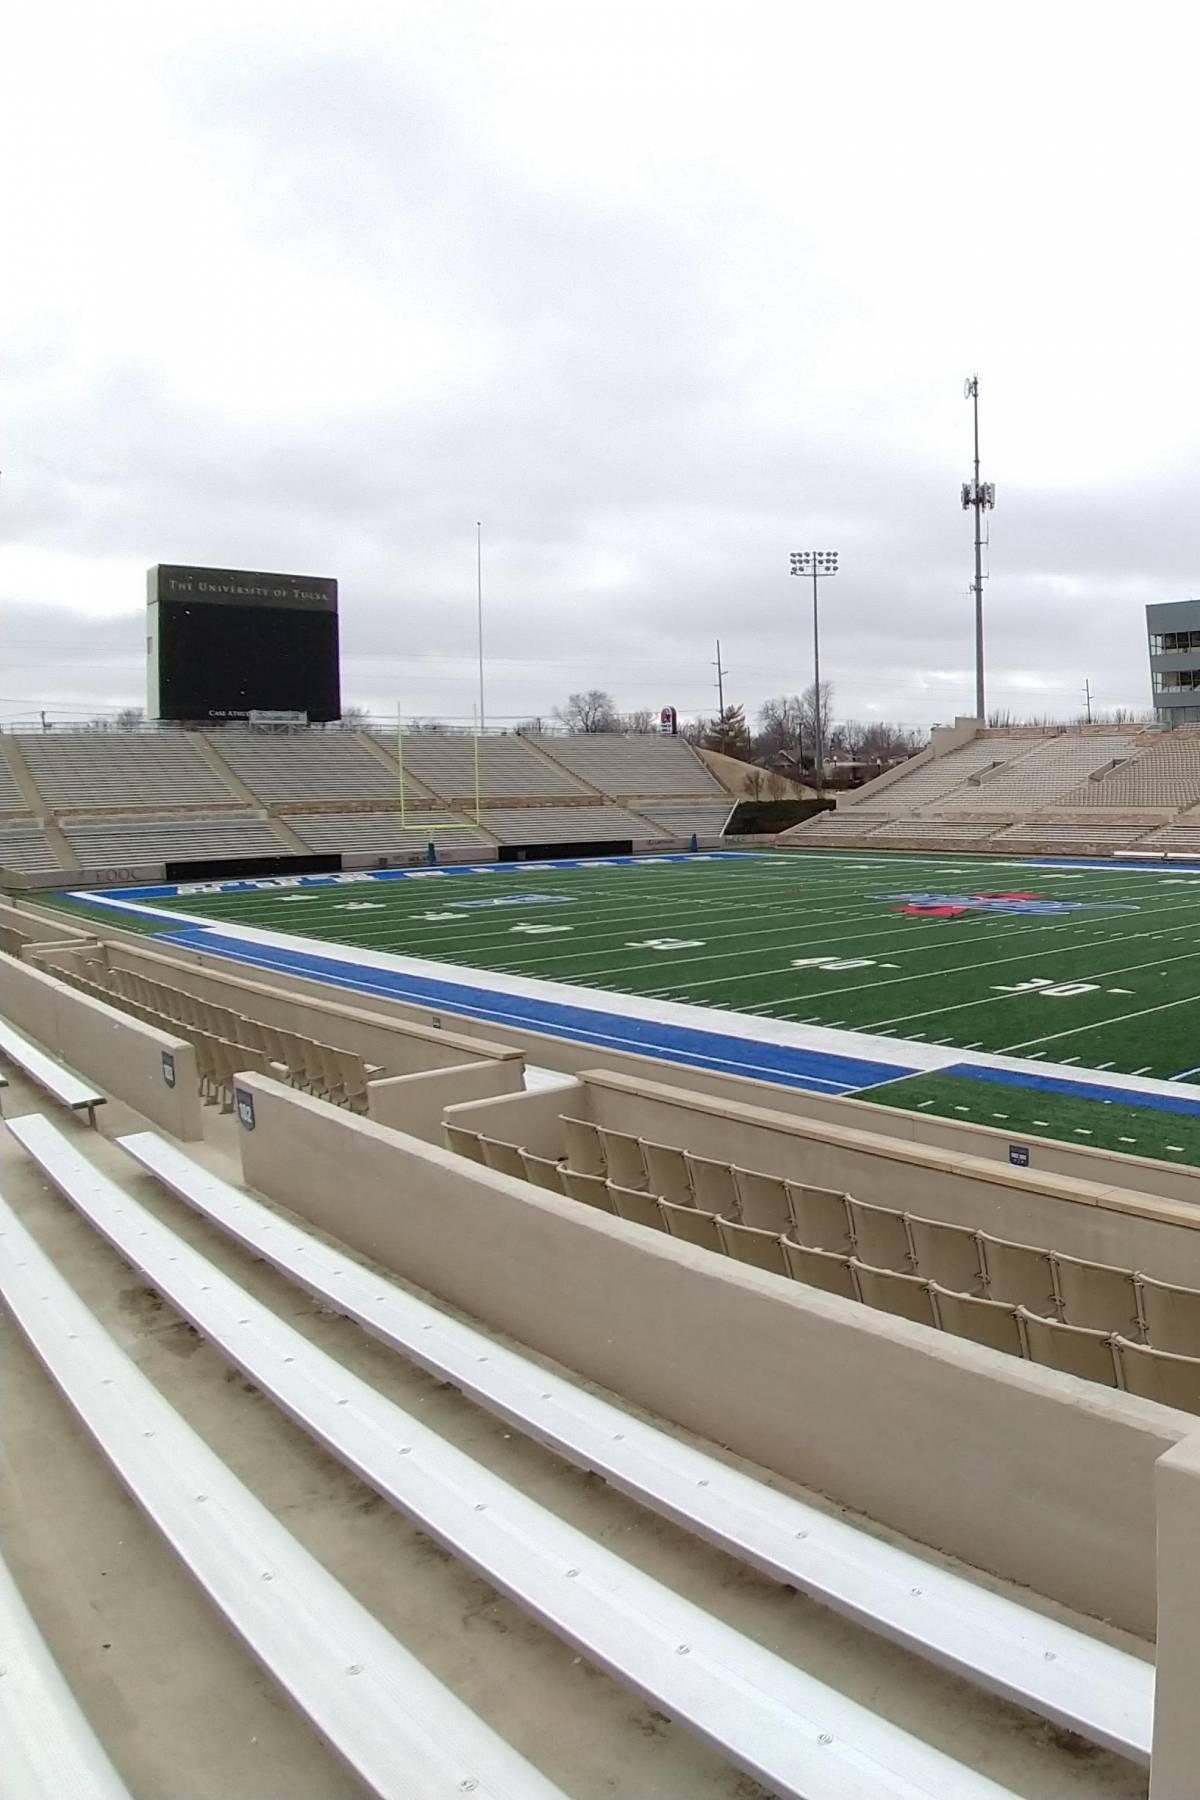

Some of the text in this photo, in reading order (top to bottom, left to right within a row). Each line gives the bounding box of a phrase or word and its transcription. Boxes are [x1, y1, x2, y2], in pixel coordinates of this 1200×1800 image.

[169, 580, 328, 601] THE UNIVERSITY OF TULSA
[989, 978, 1102, 996] 30
